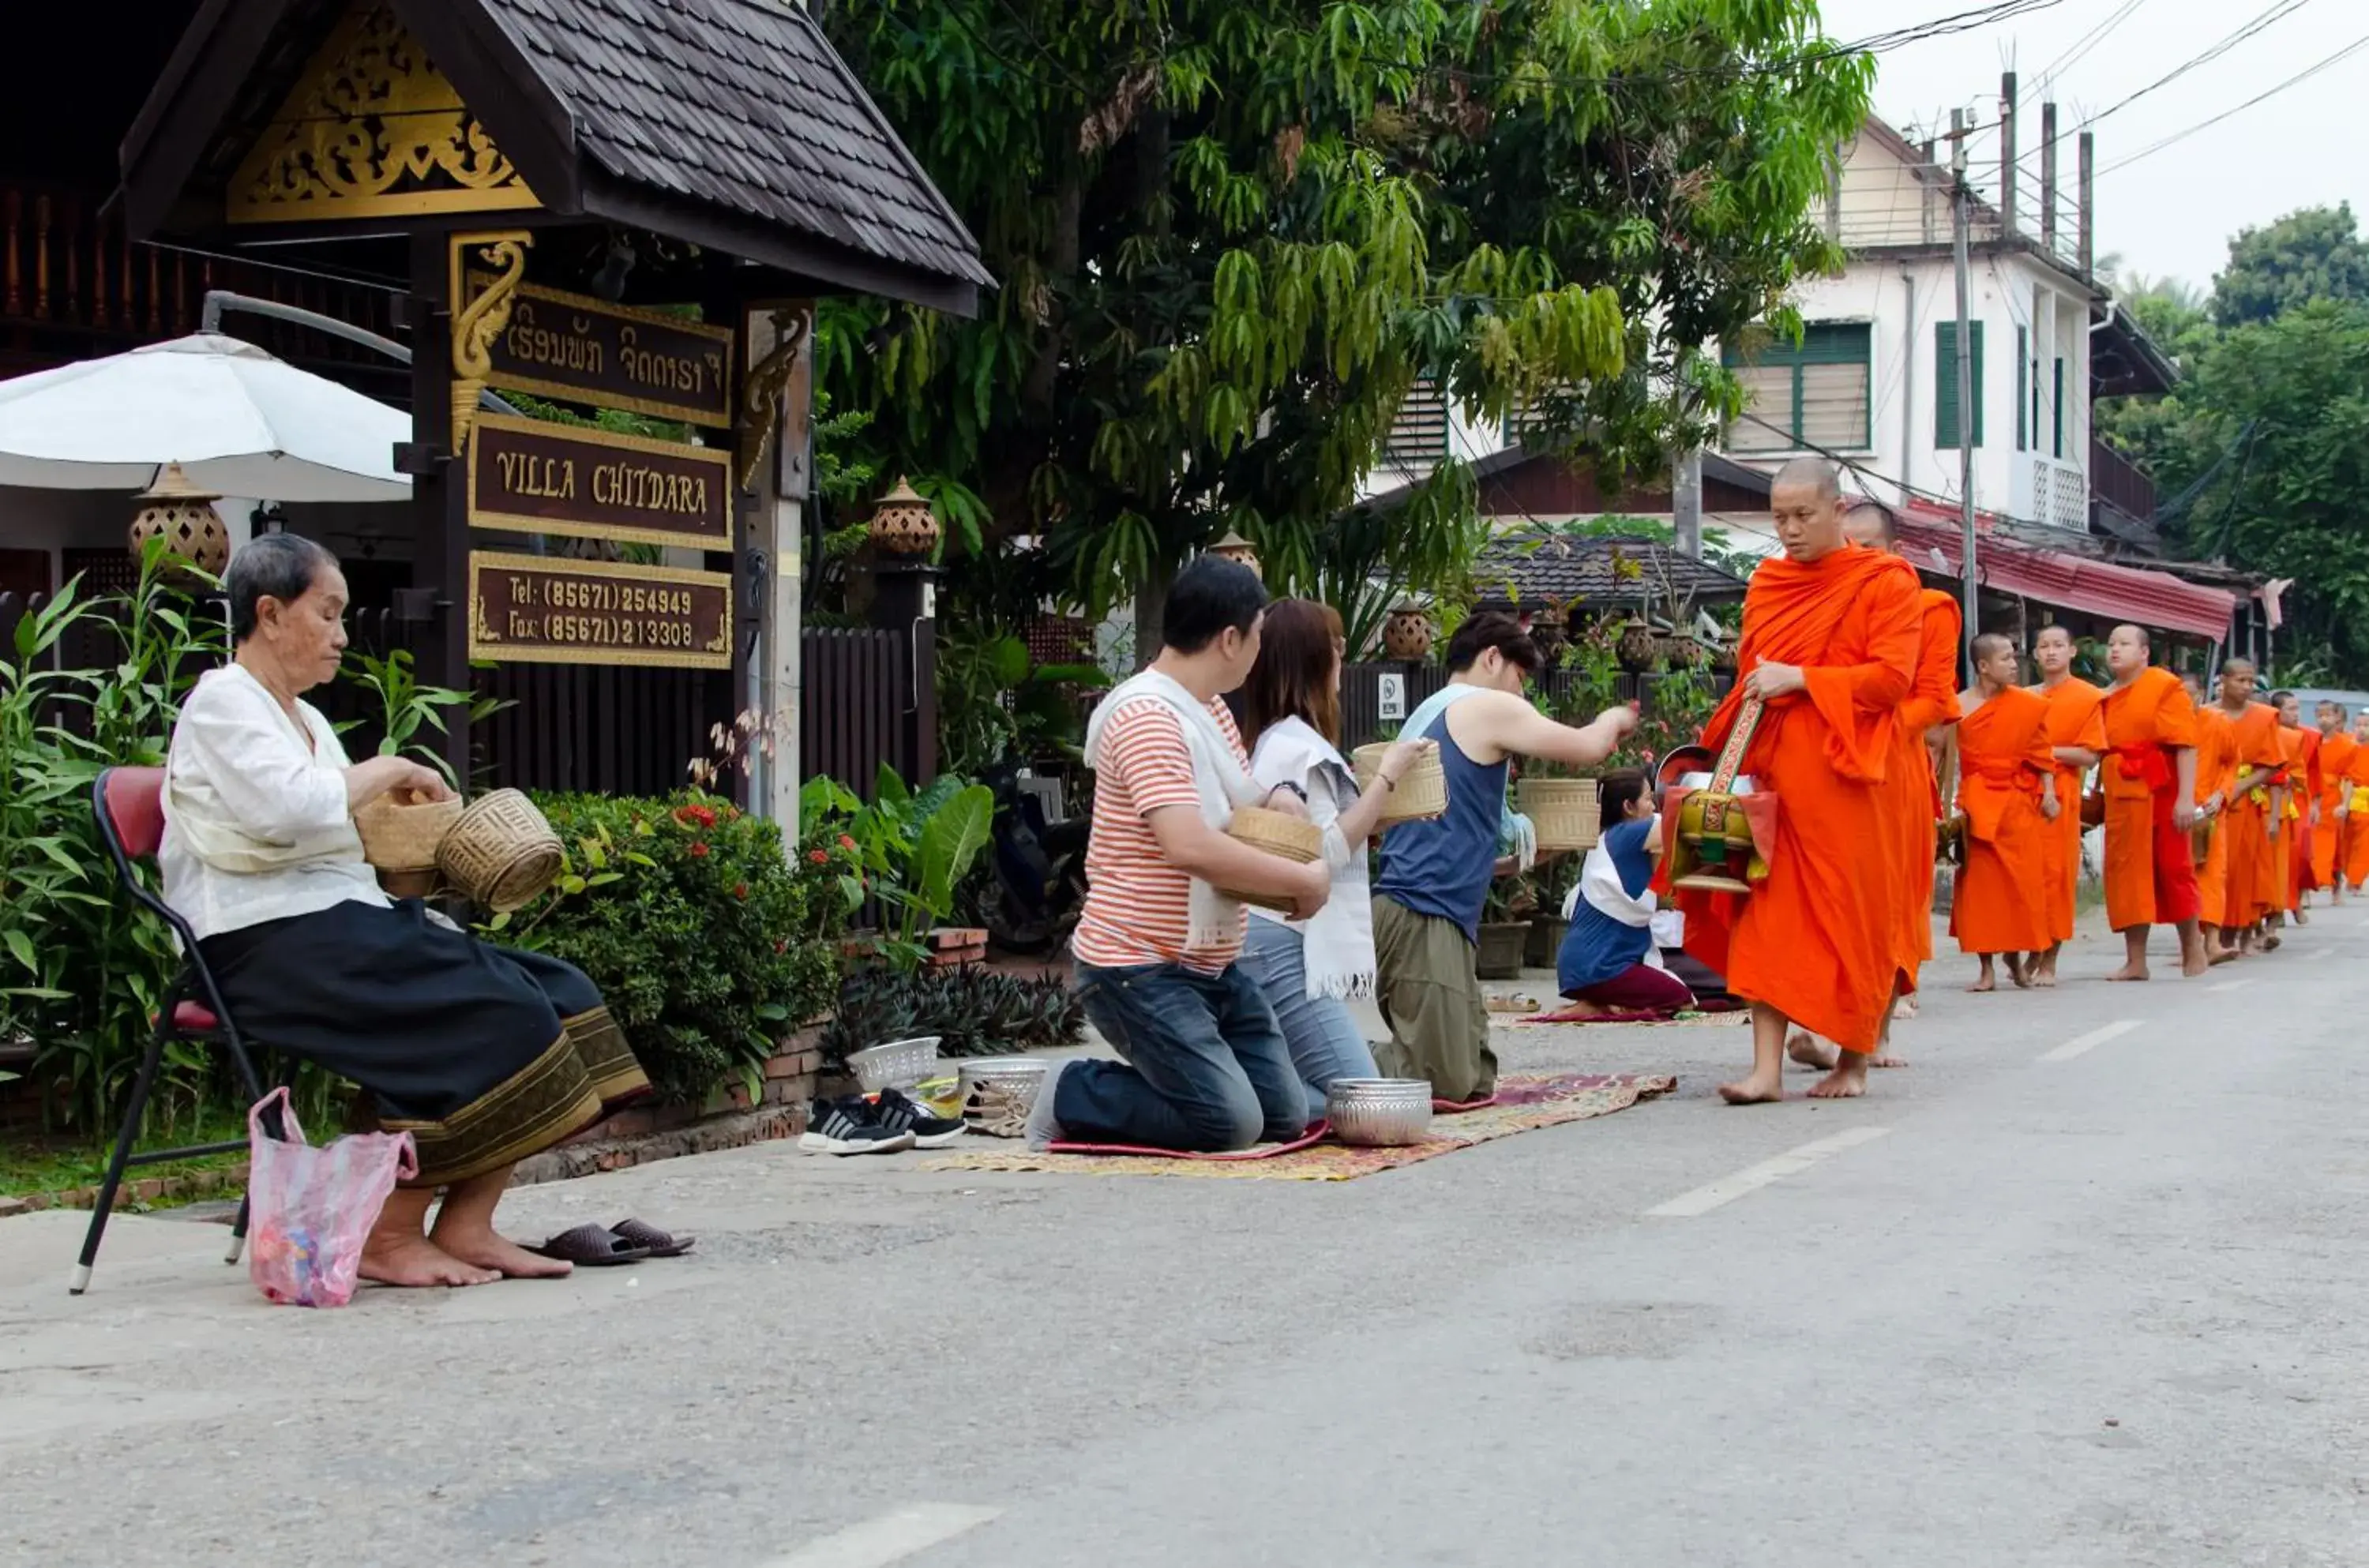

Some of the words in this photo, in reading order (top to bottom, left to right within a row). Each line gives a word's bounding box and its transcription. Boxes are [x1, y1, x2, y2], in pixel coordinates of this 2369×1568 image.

[497, 452, 576, 501] VILLA
[592, 461, 708, 515] CHITDARA
[509, 576, 538, 606] Tel:
[509, 610, 539, 639] Fax:
